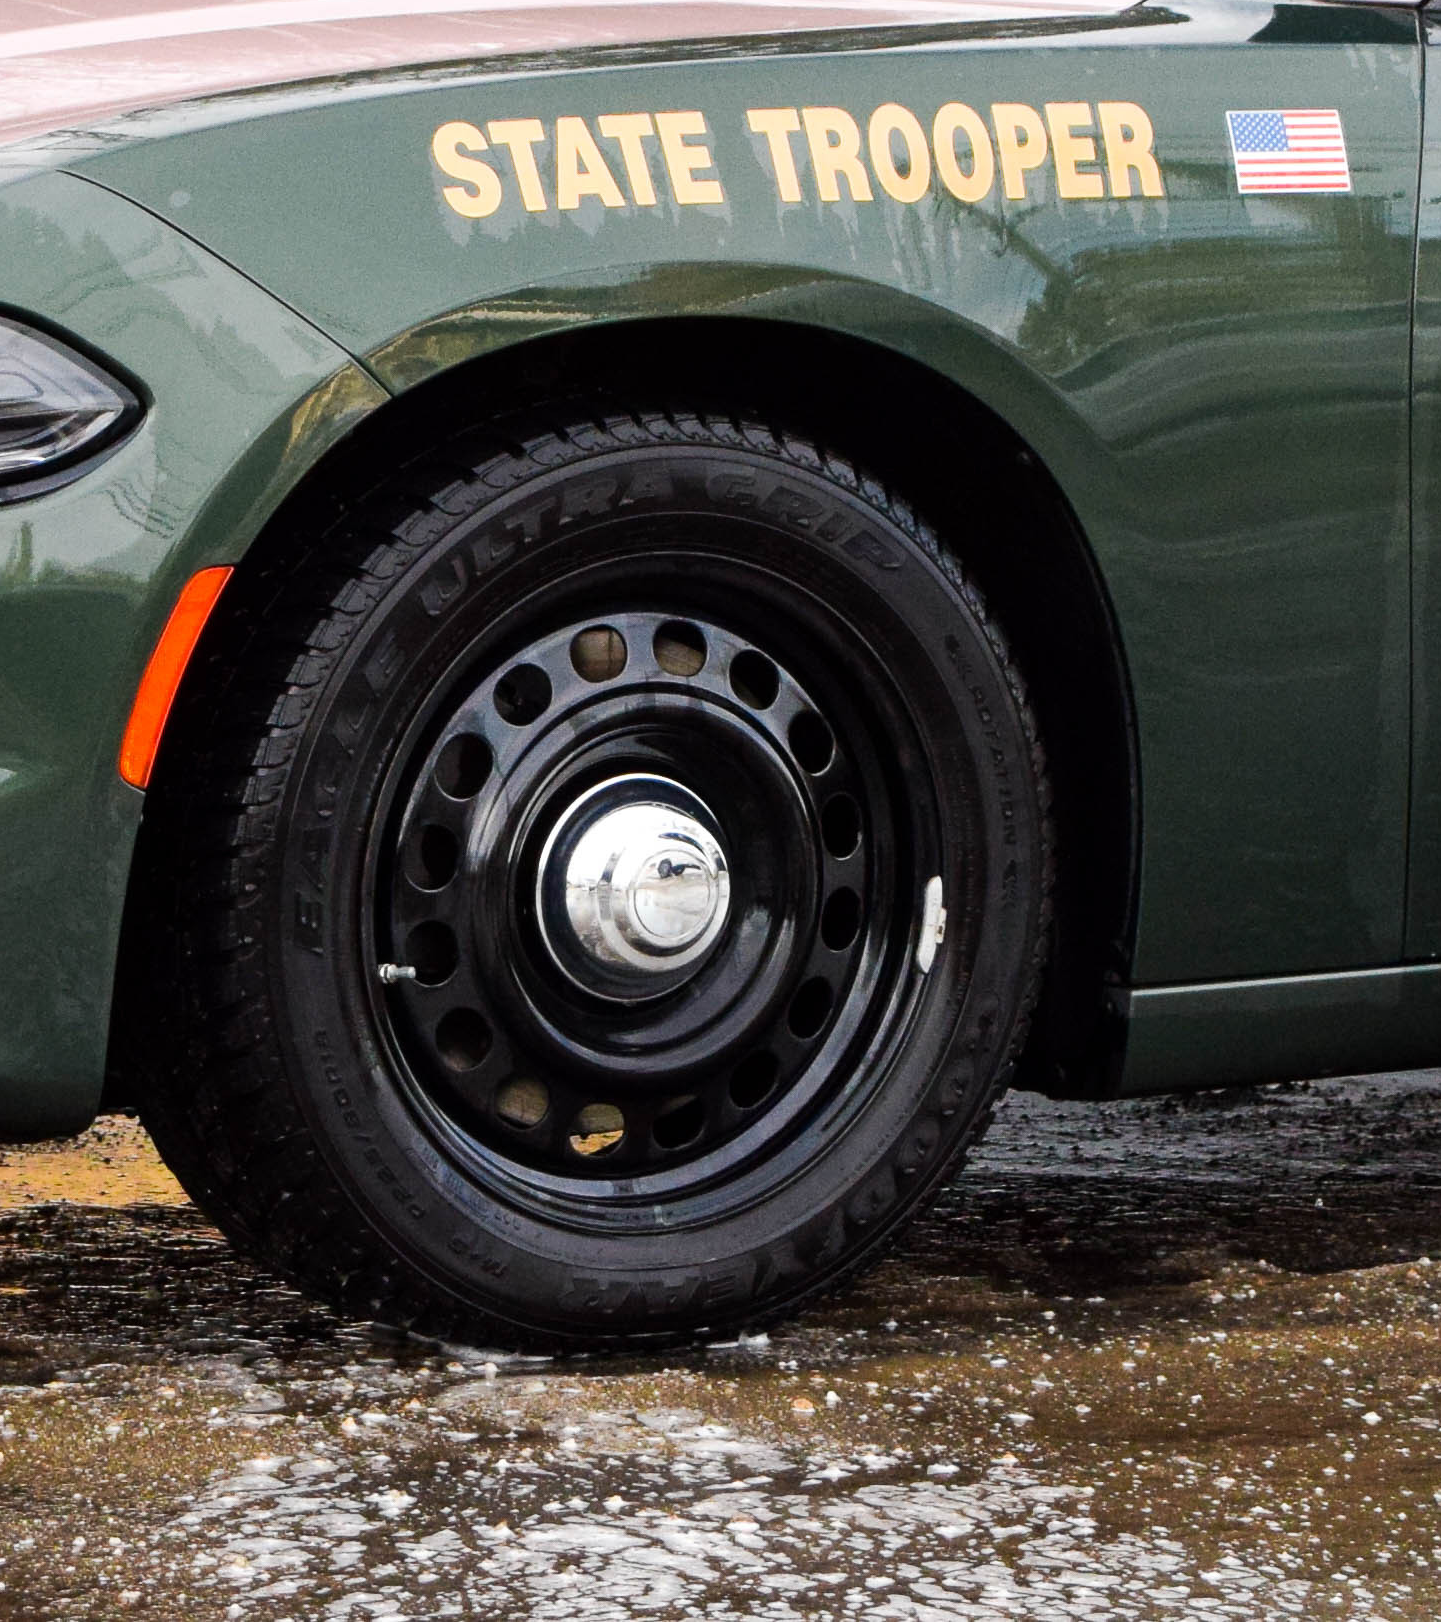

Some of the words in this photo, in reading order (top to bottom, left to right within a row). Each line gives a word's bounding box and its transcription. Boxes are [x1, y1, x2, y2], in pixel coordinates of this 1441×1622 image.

[431, 110, 725, 218] STATE
[747, 102, 1165, 203] TROOPER
[416, 468, 676, 618] ULTRA
[705, 471, 907, 570] GRIP
